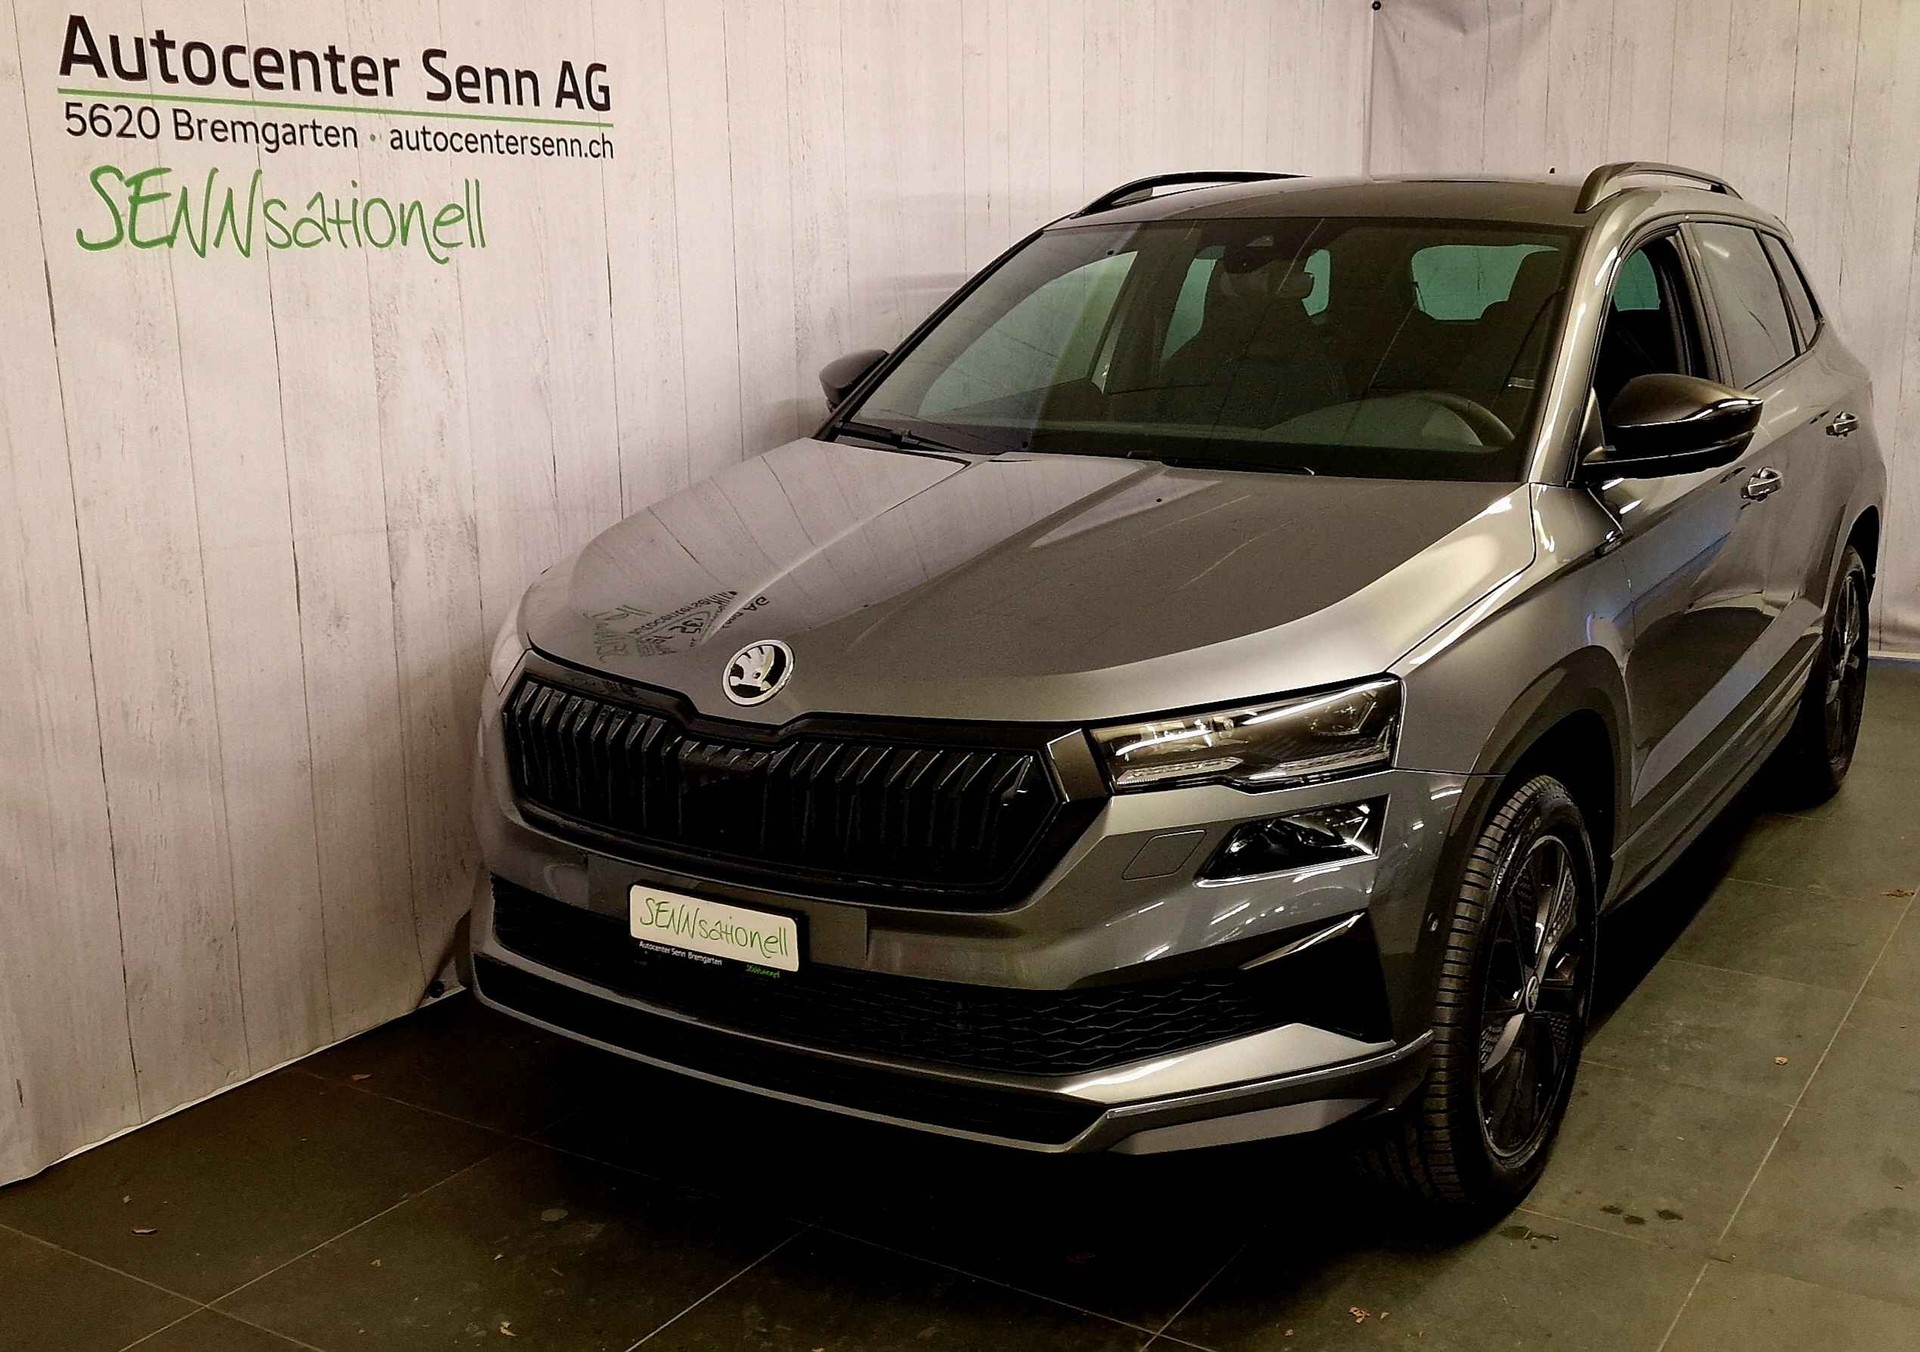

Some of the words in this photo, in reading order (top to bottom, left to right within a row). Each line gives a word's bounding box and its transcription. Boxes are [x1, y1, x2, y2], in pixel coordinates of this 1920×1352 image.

[59, 14, 400, 98] Autocenter
[421, 48, 541, 108] Senn
[555, 60, 612, 112] AG
[65, 101, 161, 140] 5620
[172, 107, 359, 154] Bremgarten
[389, 125, 614, 160] autocentersenn.ch
[75, 164, 486, 265] SENNsationell
[638, 940, 672, 955] Autocenter
[671, 946, 687, 959] Senn
[687, 951, 723, 966] Bremgarten
[639, 897, 789, 959] SENNsationell
